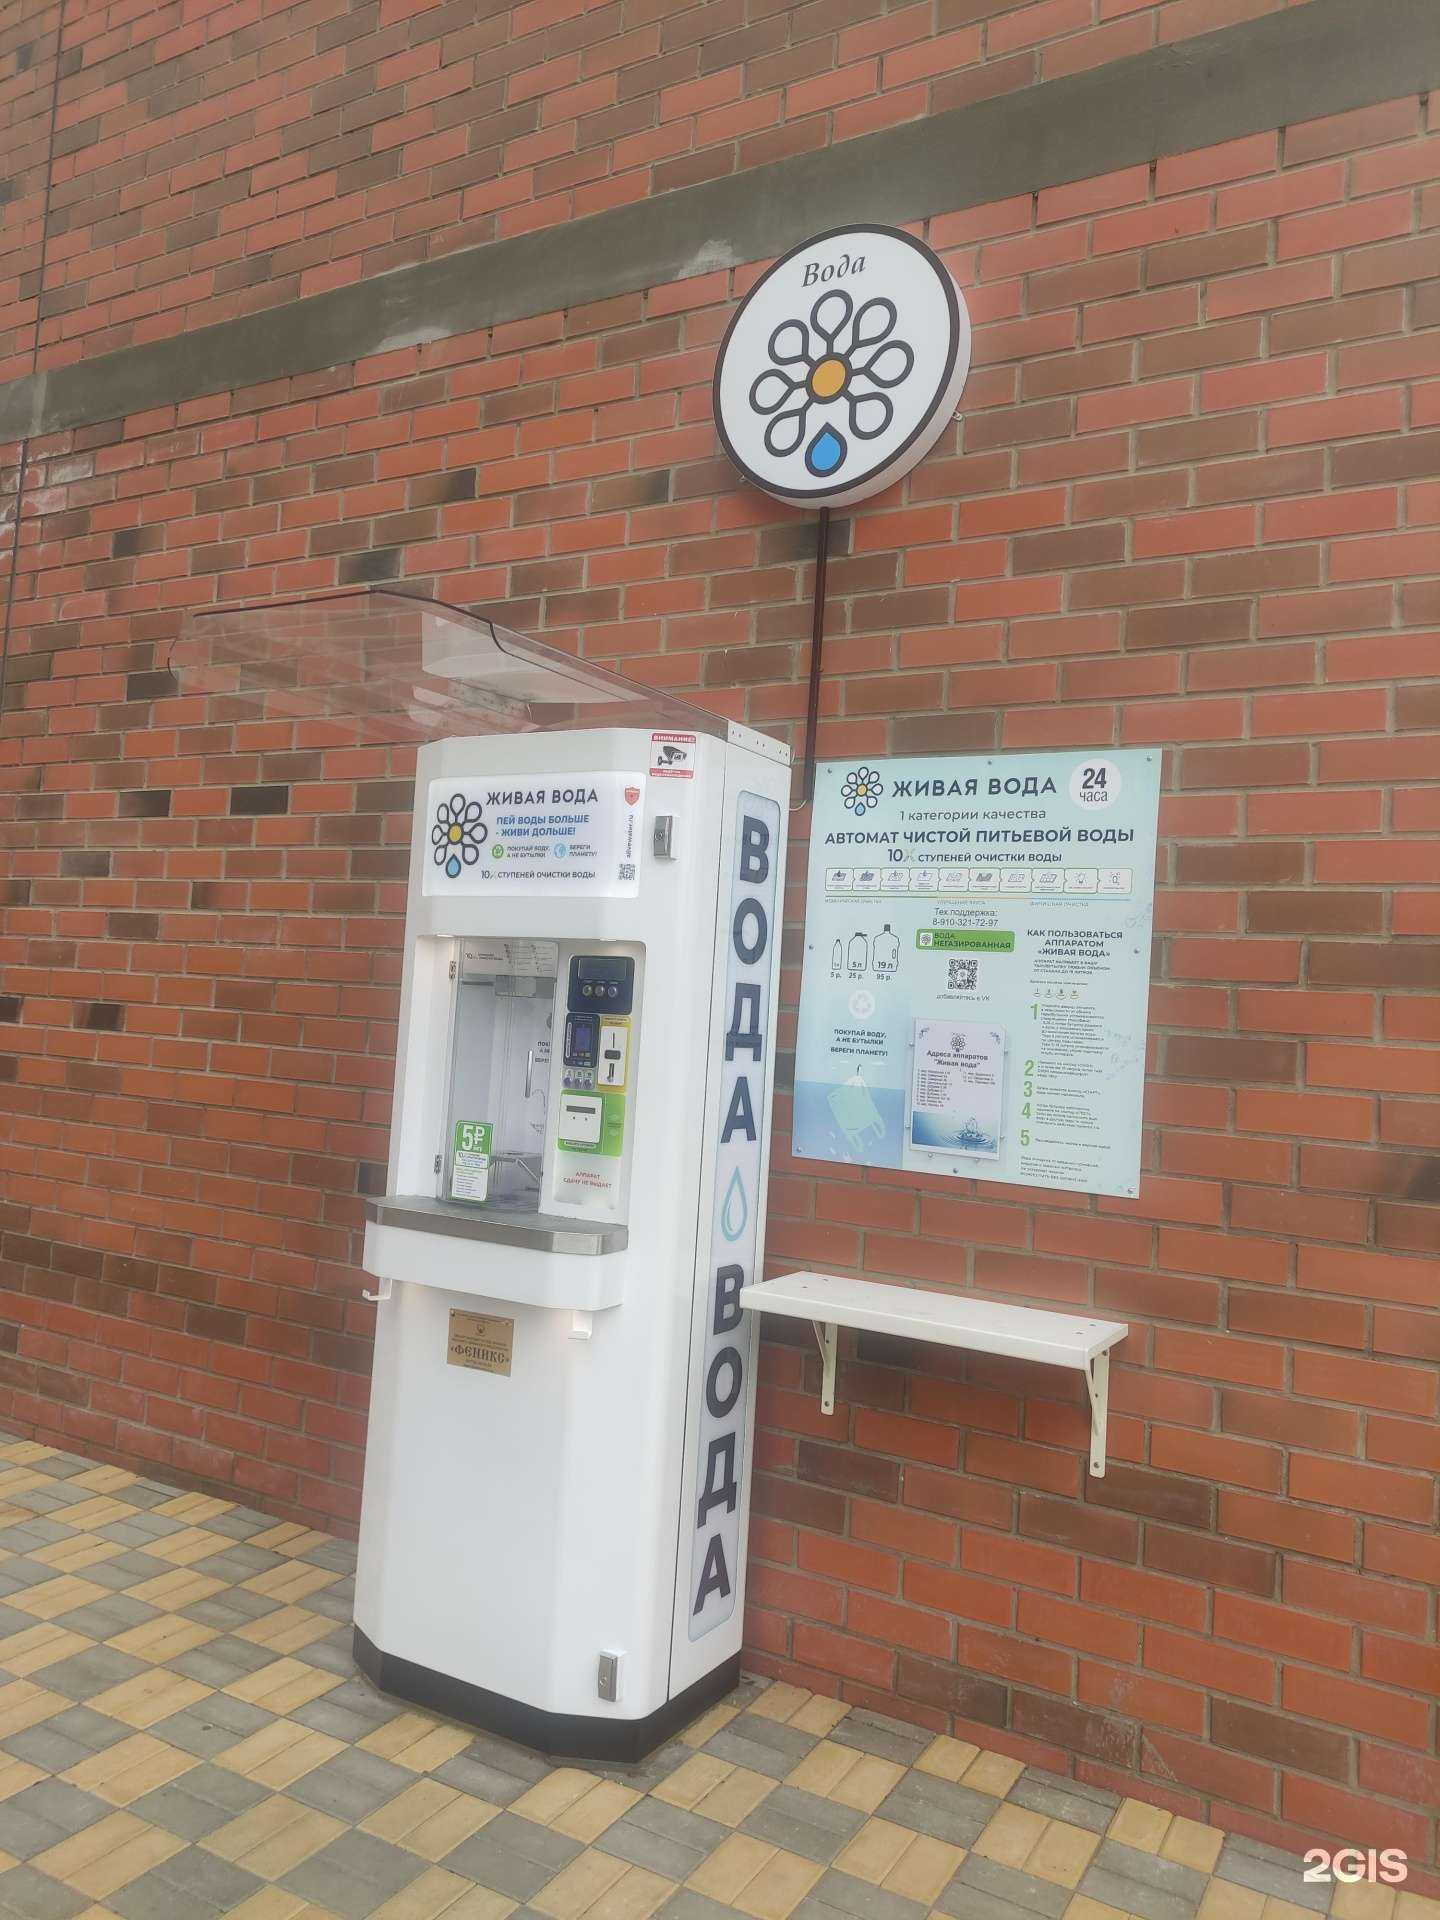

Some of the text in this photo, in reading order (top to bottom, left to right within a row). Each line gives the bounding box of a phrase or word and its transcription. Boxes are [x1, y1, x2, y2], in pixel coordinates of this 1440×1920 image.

[802, 254, 866, 287] Вода
[892, 776, 1057, 797] ЖИВАЯ ВОДА
[1082, 768, 1107, 789] 24
[486, 788, 598, 806] ЖИВАЯ ВОДА
[1080, 790, 1108, 802] часа
[496, 814, 590, 826] ПЕЙ ВОДЫ БОЛЬШЕ
[900, 808, 1046, 823] 1 категории качества
[501, 828, 530, 837] ЖИВИ
[824, 826, 1134, 844] АВТОМАТ ЧИСТОЙ ПИТЬЕВОЙ ВОДЫ
[918, 852, 972, 862] СТУПЕНЕЙ
[974, 853, 1025, 862] ОЧИСТКИ
[1028, 853, 1062, 863] ВОДЫ
[498, 870, 535, 879] СТУПЕНЕЙ
[572, 871, 596, 879] ВОДЫ
[1048, 930, 1122, 939] ПОЛЬЗОВАТЬСЯ
[934, 940, 1010, 949] НЕГАЗИРОВАННАЯ
[1044, 940, 1104, 948] АППАРАТОМ
[1038, 948, 1110, 958] «ЖИВАЯ ВОДА»
[720, 814, 770, 1143] ВОДА
[1030, 1004, 1038, 1020] 1
[926, 1050, 951, 1058] Адреса
[1024, 1060, 1034, 1076] 2
[1024, 1080, 1032, 1098] 3
[1022, 1102, 1032, 1119] 4
[1020, 1130, 1030, 1146] 5
[693, 1263, 745, 1616] ВОДА
